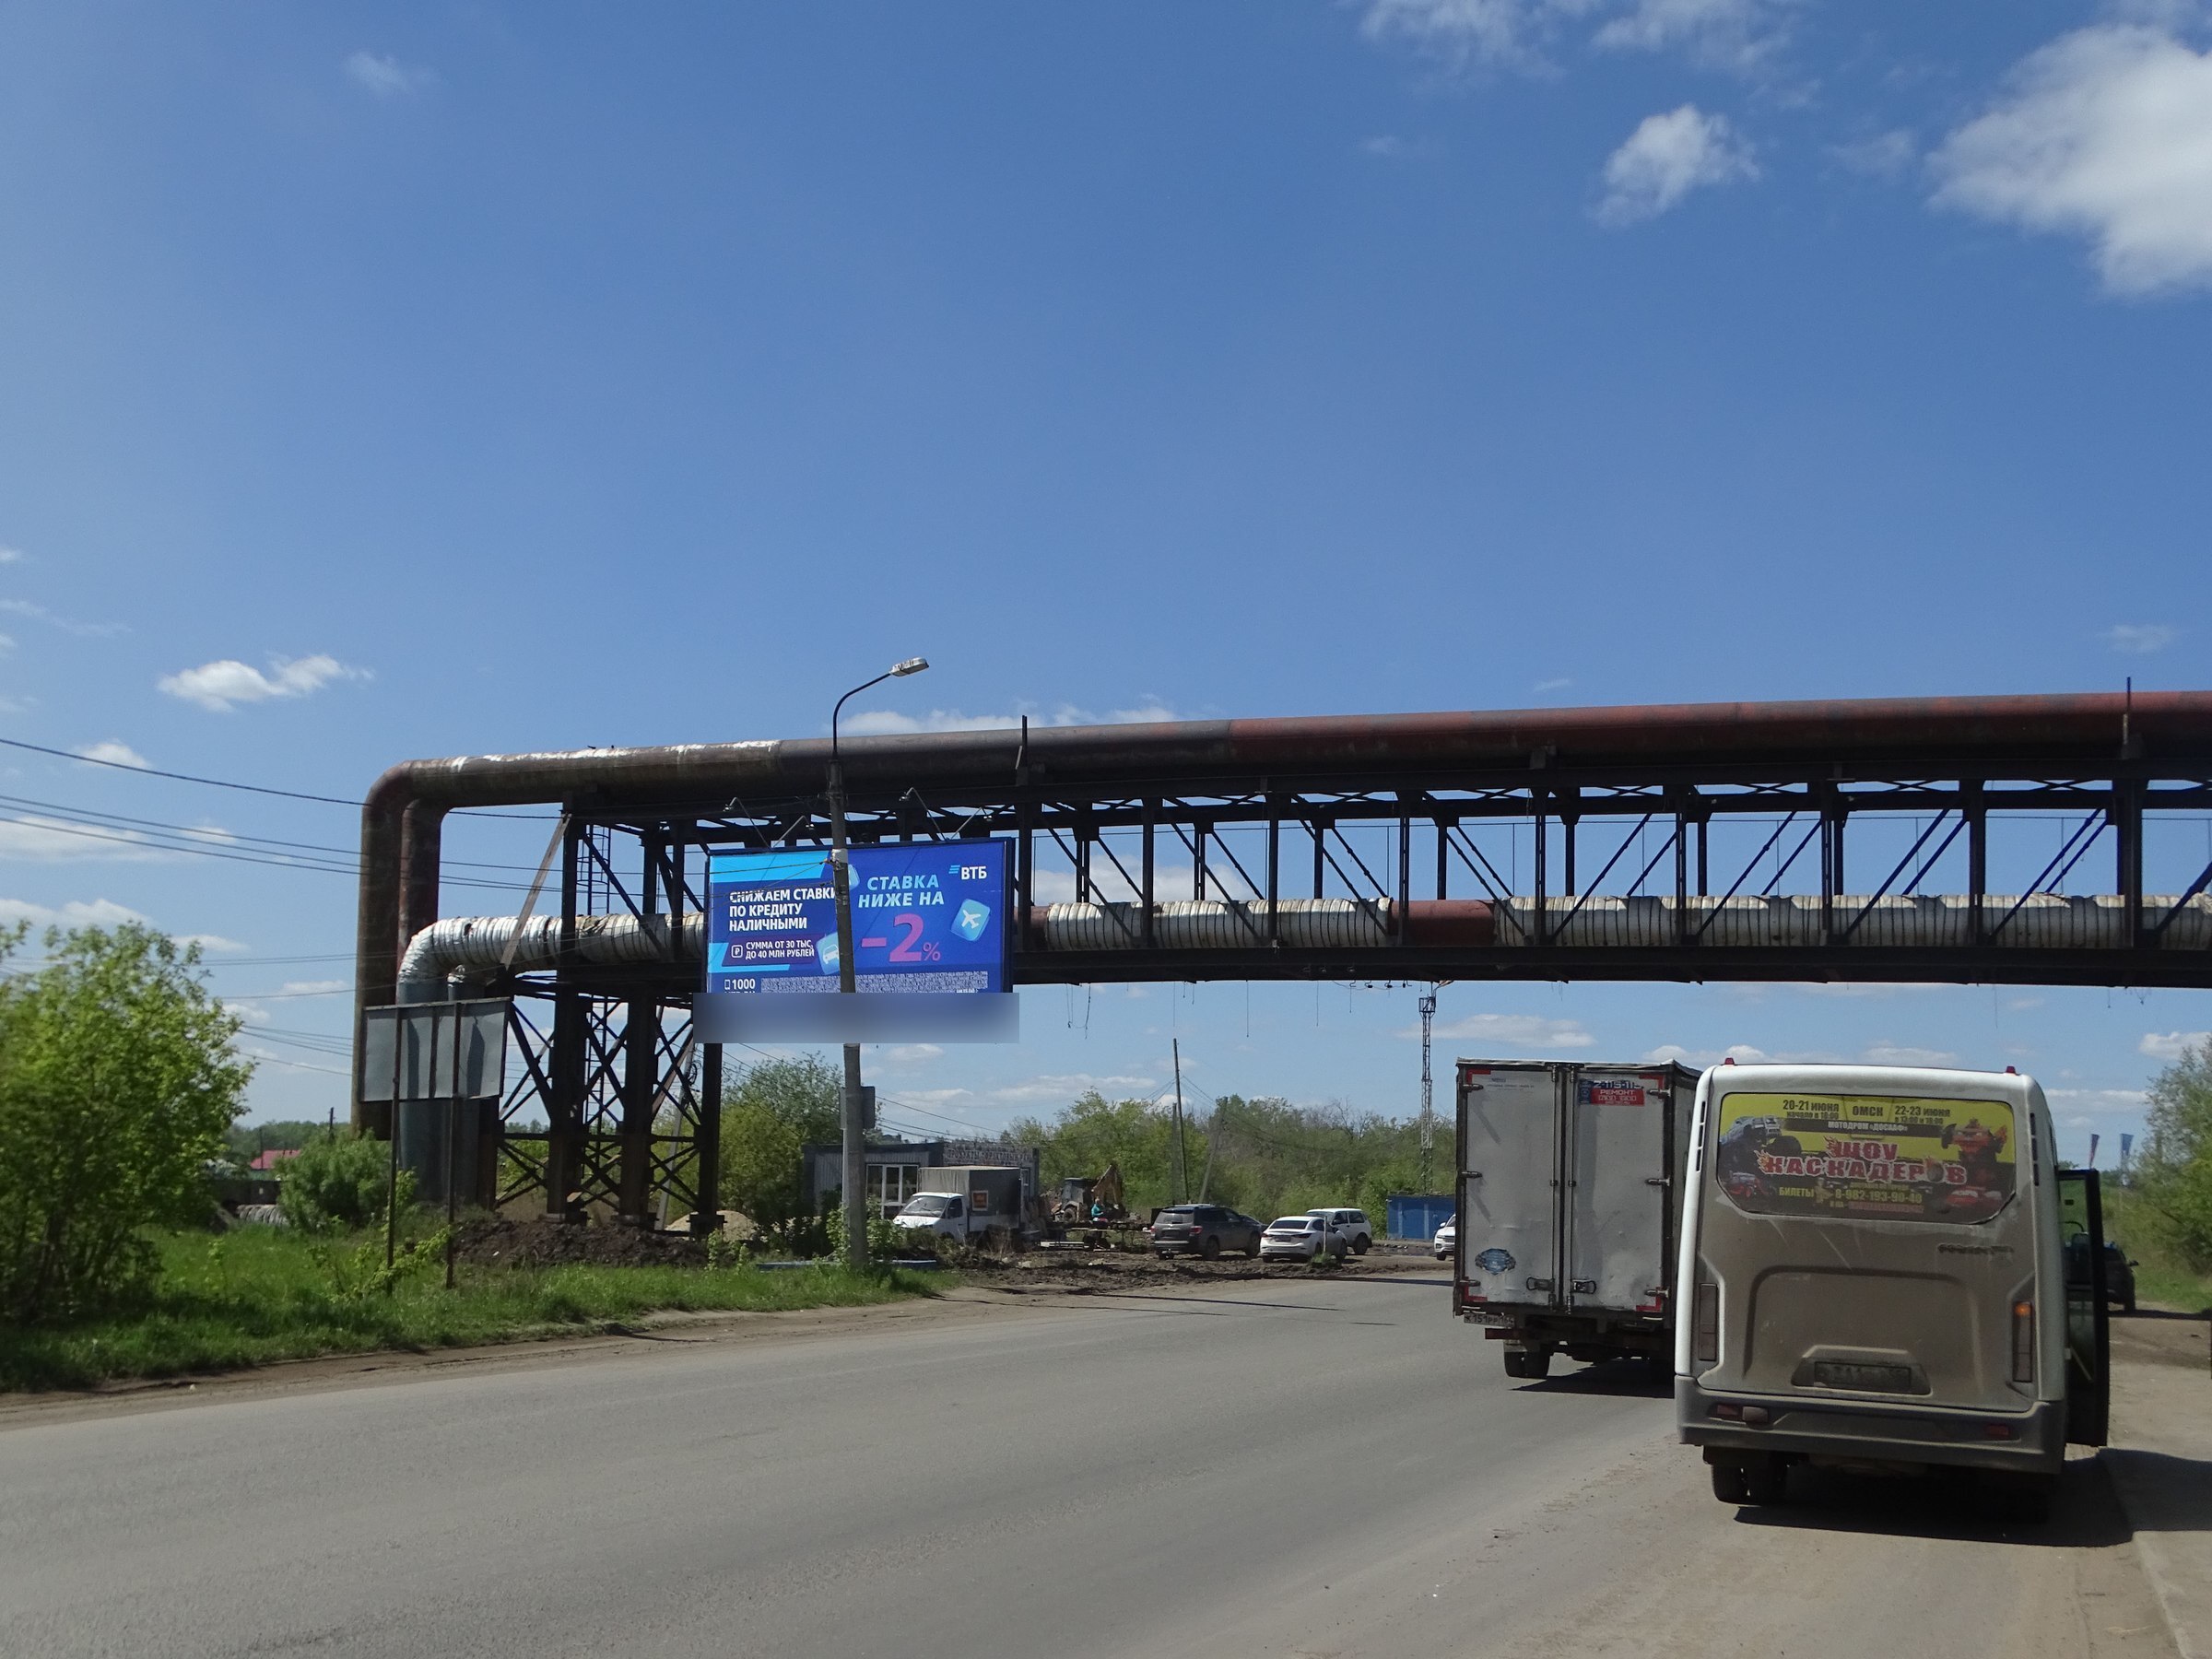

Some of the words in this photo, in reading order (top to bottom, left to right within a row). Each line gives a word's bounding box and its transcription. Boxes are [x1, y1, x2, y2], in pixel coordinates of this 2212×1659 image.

[961, 865, 988, 880] ВТБ
[867, 874, 940, 890] СТАВКА
[729, 888, 791, 903] СНИЖАЕМ
[858, 892, 913, 908] НИЖЕ
[919, 891, 945, 906] НА
[729, 905, 747, 917] ПО
[748, 903, 803, 918] КРЕДИТУ
[729, 917, 807, 932] НАЛИЧНЫМИ
[746, 941, 773, 950] СУММА
[774, 940, 785, 949] ОТ
[785, 940, 795, 948] 30
[745, 950, 757, 960] ДО
[758, 950, 768, 959] 40
[769, 949, 785, 958] МЛН
[786, 947, 815, 958] РУБЛЕЙ
[732, 978, 756, 990] 1000
[1783, 1099, 1809, 1111] 20-21
[1852, 1105, 1884, 1117] ОМСК
[1894, 1105, 1922, 1116] 22-23
[1828, 1121, 1870, 1131] МОТОДРОМ
[1830, 1141, 1899, 1161] ШОУ
[1779, 1186, 1815, 1197] БИЛЕТЫ
